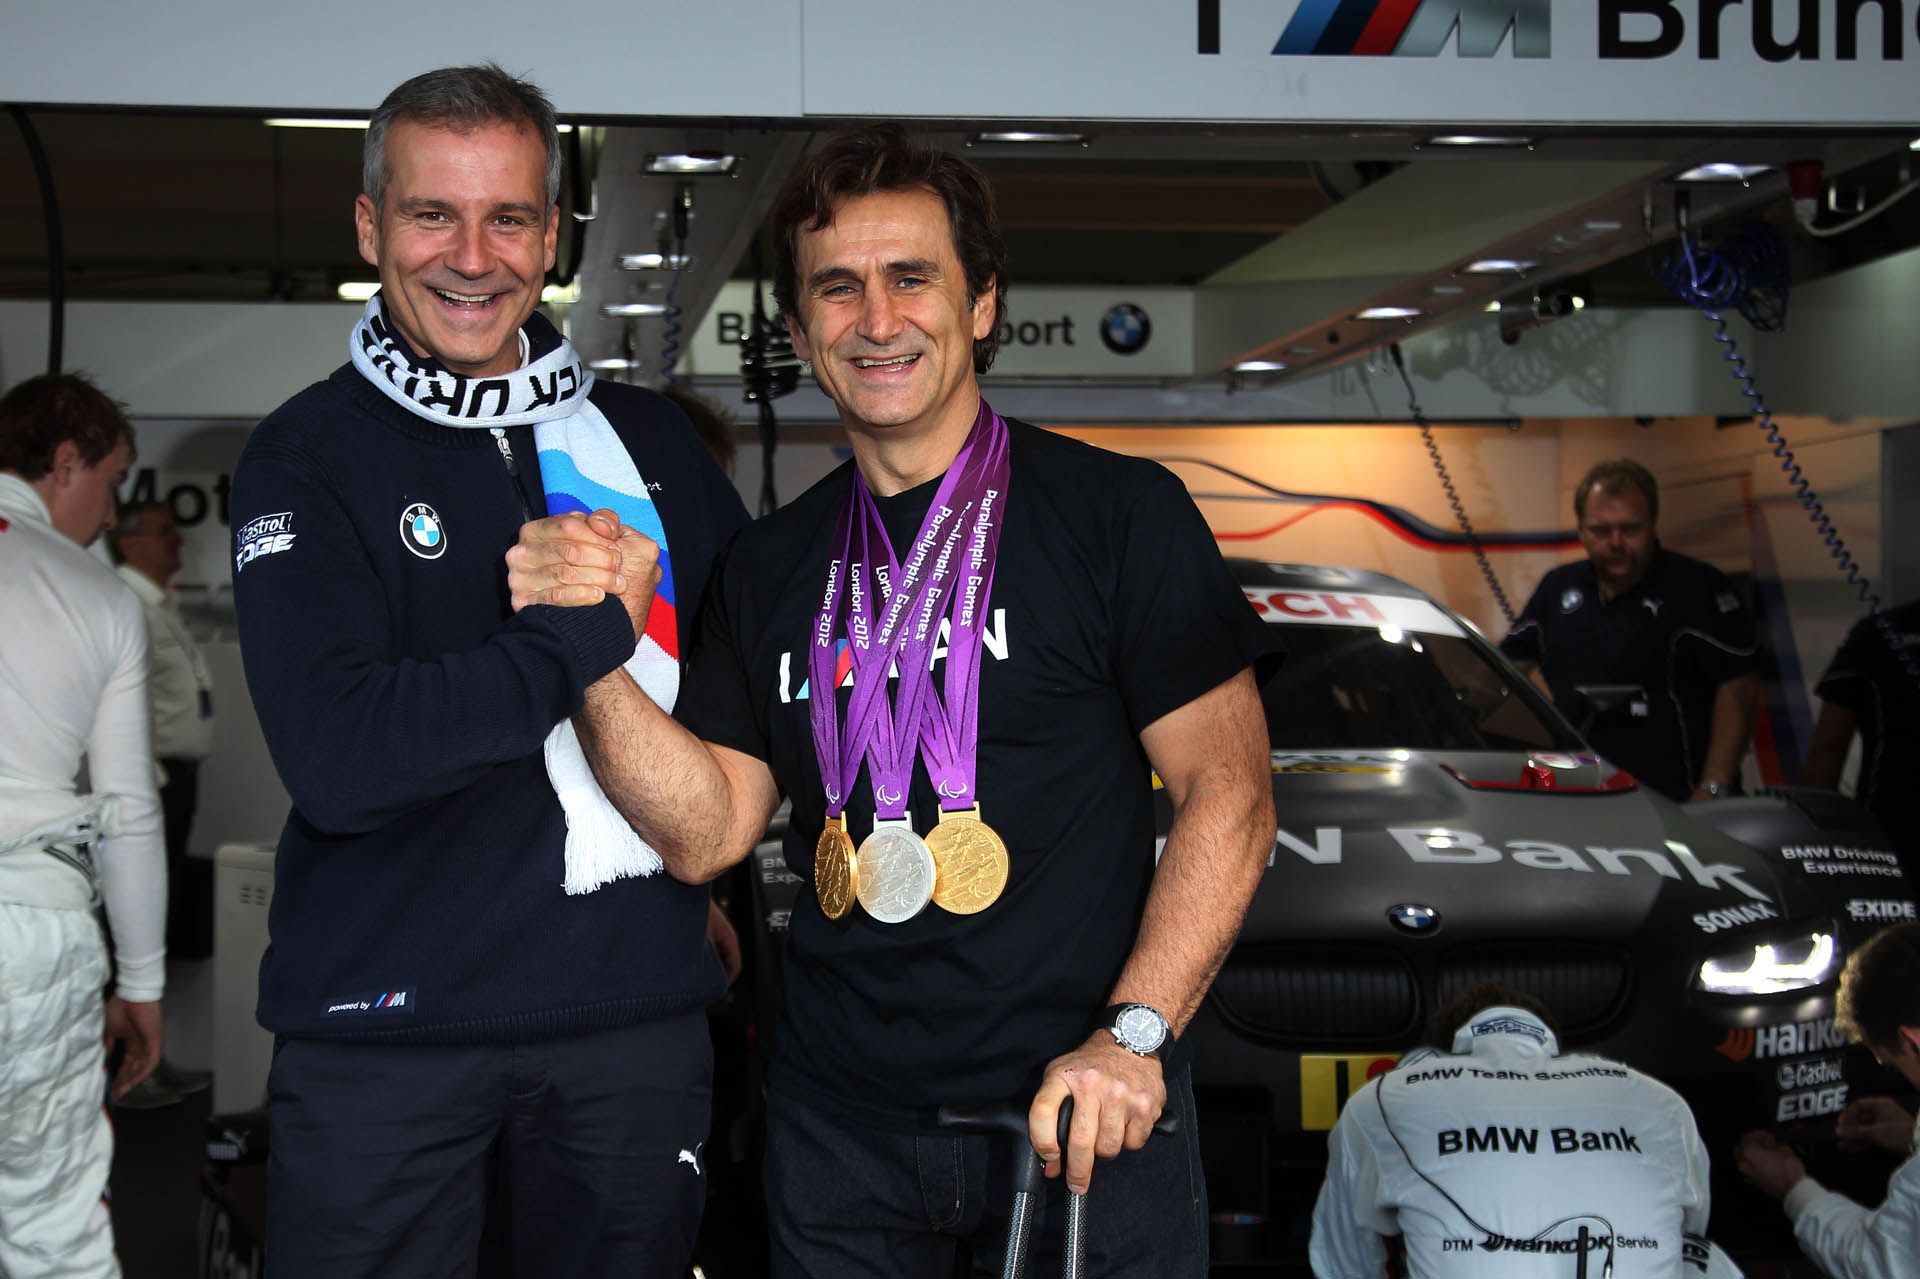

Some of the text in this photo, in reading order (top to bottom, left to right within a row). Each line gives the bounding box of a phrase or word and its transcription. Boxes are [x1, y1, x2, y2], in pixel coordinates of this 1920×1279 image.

[1598, 0, 1920, 63] Brun
[236, 533, 297, 572] EDGE
[960, 488, 999, 628] Paralympic Games
[878, 505, 953, 646] Paralympic Games
[816, 559, 842, 649] London 2012
[850, 562, 870, 650] London 2012
[915, 587, 943, 642] Games
[1386, 827, 1774, 903] Bank
[1782, 846, 1899, 865] BMW Driving
[1803, 861, 1904, 878] Experience
[1693, 902, 1779, 934] SONAX
[1848, 900, 1917, 919] EXIDE
[328, 1001, 359, 1013] powered
[360, 1001, 370, 1011] by
[1405, 1067, 1464, 1085] BMW
[1468, 1068, 1531, 1081] Team
[1775, 1084, 1849, 1122] EDGE
[1437, 1126, 1643, 1157] BMW Bank
[1442, 1239, 1473, 1252] DTM
[1616, 1235, 1659, 1250] Service
